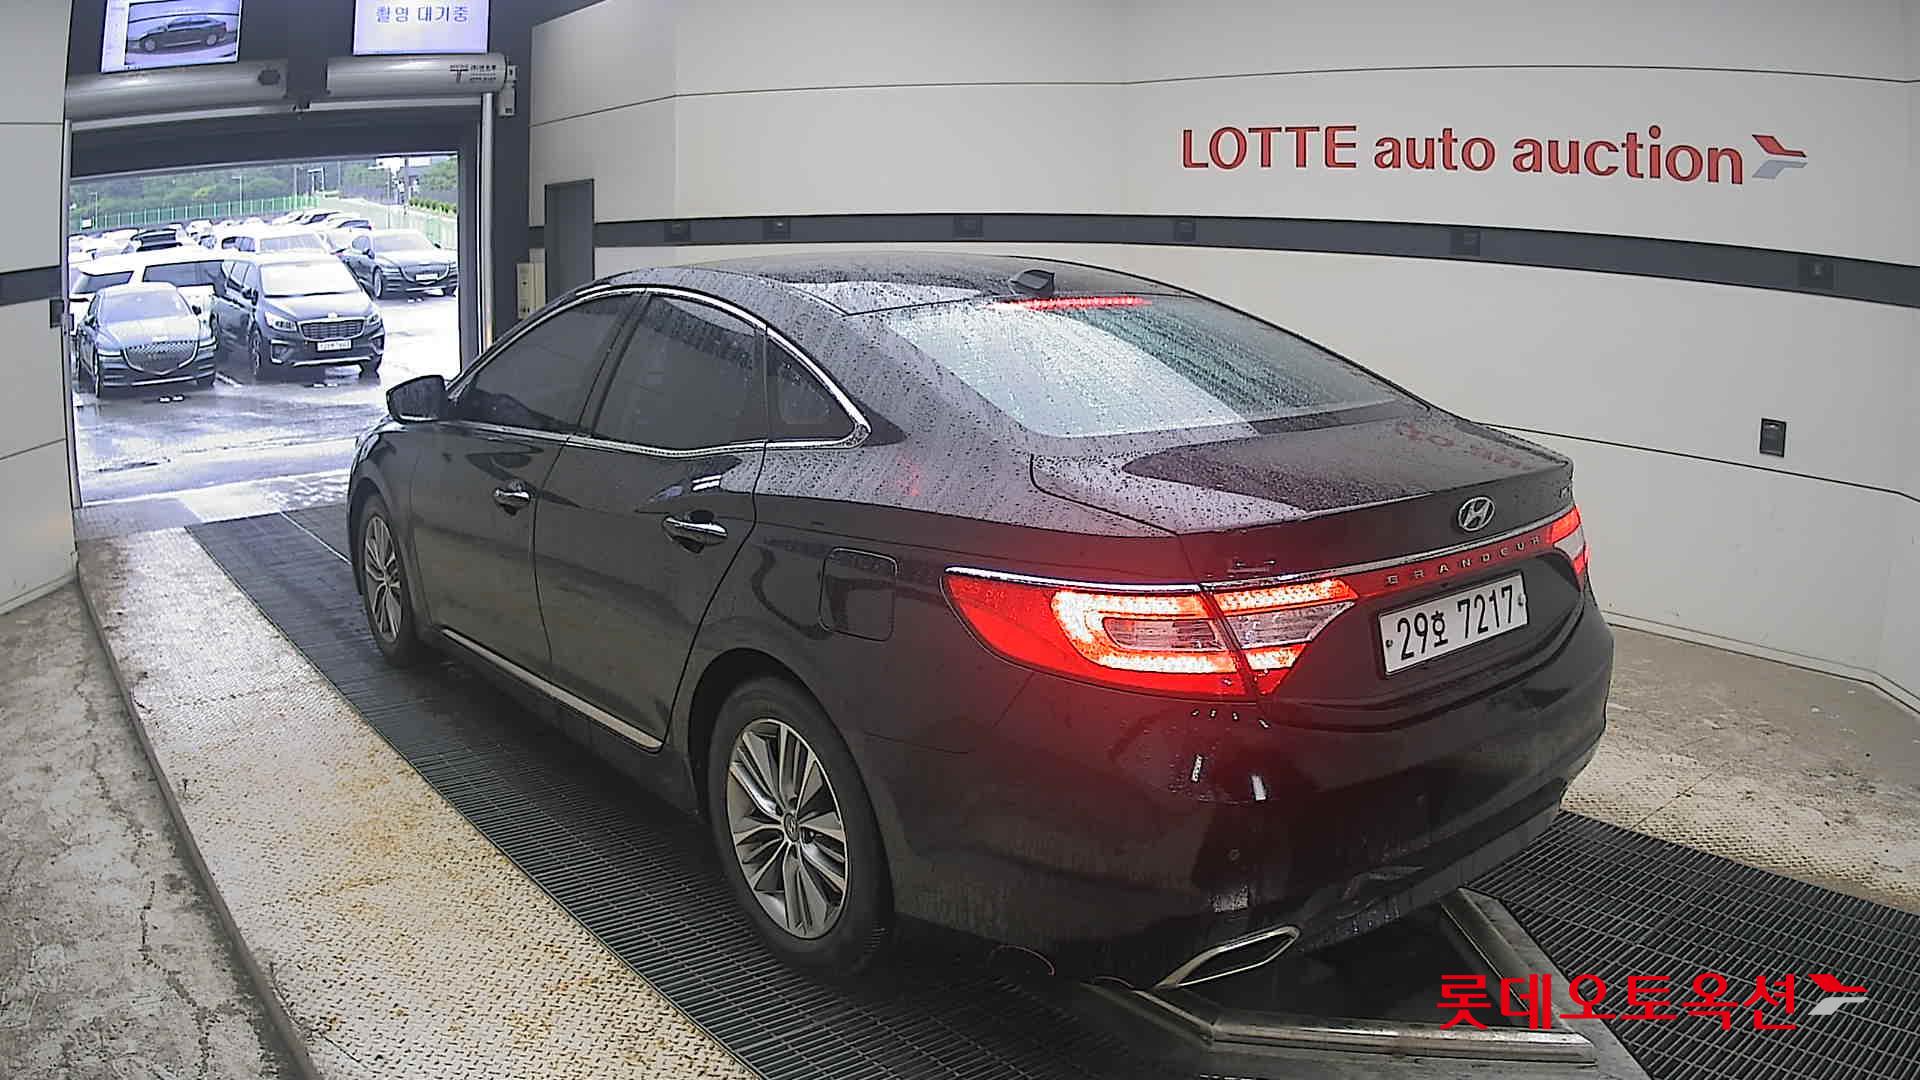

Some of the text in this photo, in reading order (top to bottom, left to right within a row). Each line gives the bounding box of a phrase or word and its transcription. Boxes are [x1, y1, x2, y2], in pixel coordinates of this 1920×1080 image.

[417, 5, 470, 22] 대기중
[1182, 124, 1744, 185] LOTTE auto auction
[1386, 535, 1541, 585] GRANDEUR
[1396, 584, 1514, 661] 29호 7217
